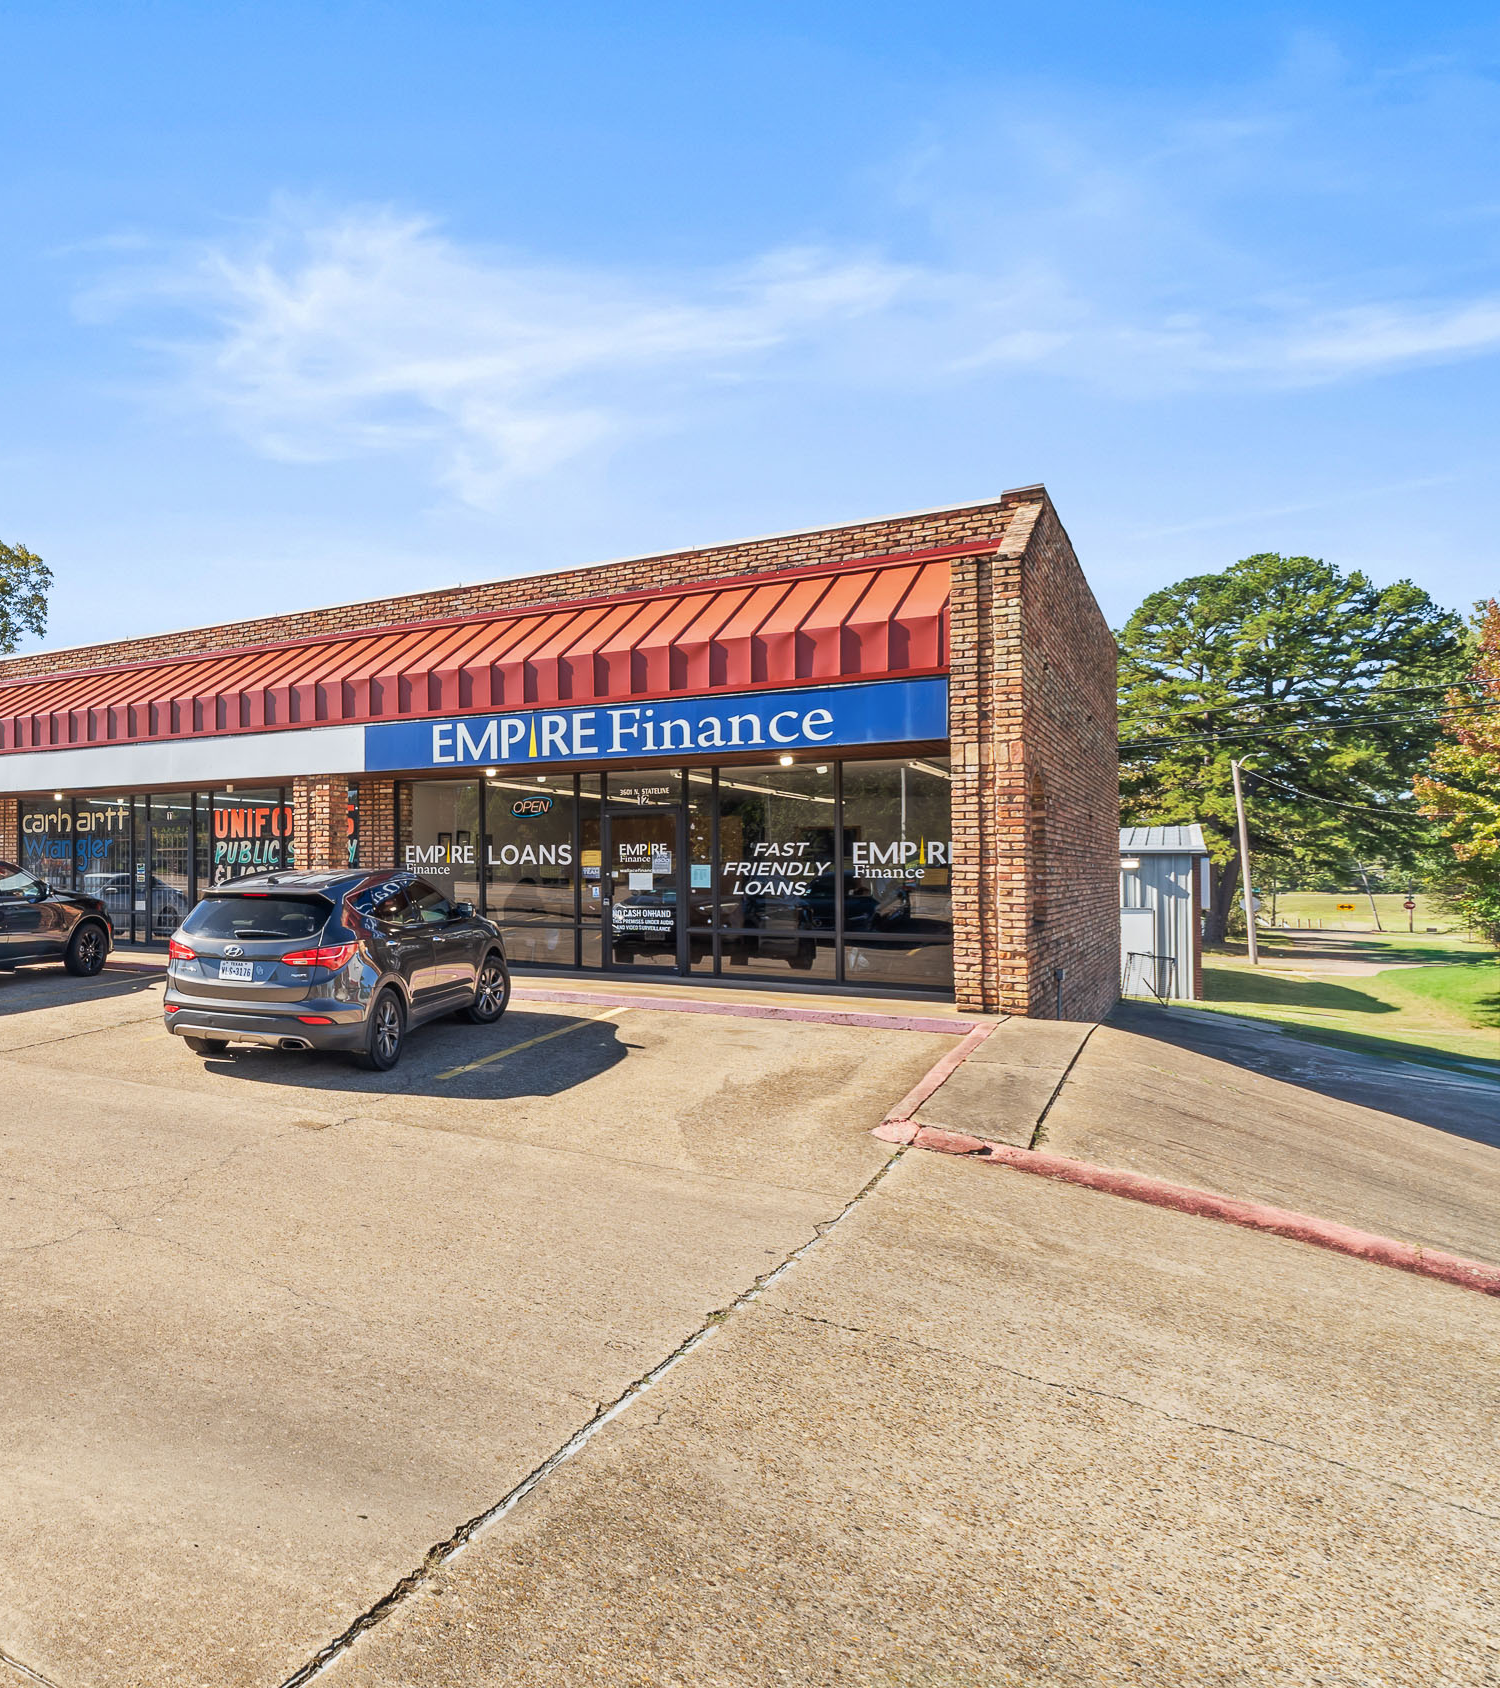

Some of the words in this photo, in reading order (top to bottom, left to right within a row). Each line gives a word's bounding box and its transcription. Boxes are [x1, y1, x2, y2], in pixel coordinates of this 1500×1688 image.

[432, 712, 599, 764] EMPIRE
[606, 707, 834, 754] Finance
[513, 800, 550, 813] OPEN
[22, 806, 130, 833] carhartt
[23, 834, 113, 872] Wrangler
[215, 840, 280, 863] PUBLIC
[405, 843, 475, 864] EMPIRE
[488, 844, 572, 865] LOANS
[620, 843, 667, 856] EMPIRE
[753, 842, 810, 857] FAST
[620, 855, 651, 863] Finance
[406, 863, 450, 875] Finance
[723, 862, 831, 876] FRIENDLY
[853, 865, 925, 879] Finance
